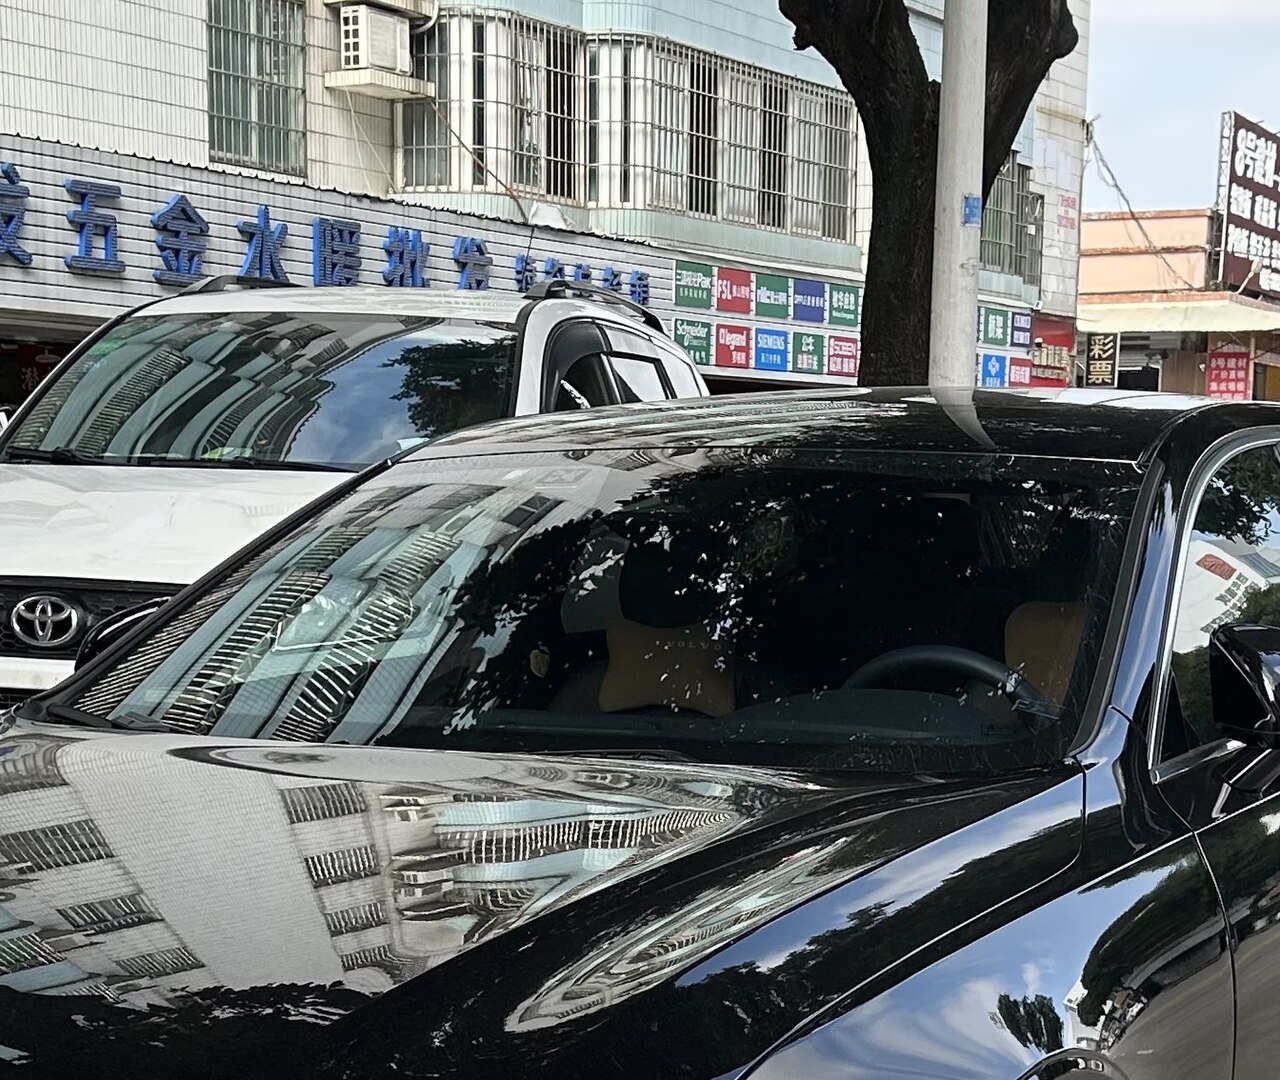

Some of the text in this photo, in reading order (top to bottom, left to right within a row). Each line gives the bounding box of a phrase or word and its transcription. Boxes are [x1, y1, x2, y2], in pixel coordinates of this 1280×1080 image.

[718, 280, 732, 300] FSL
[676, 320, 708, 338] Schneider
[725, 329, 747, 351] legrand
[757, 333, 785, 350] SIEMENS
[1089, 335, 1114, 384] 彩票
[667, 641, 722, 651] VOLVO
